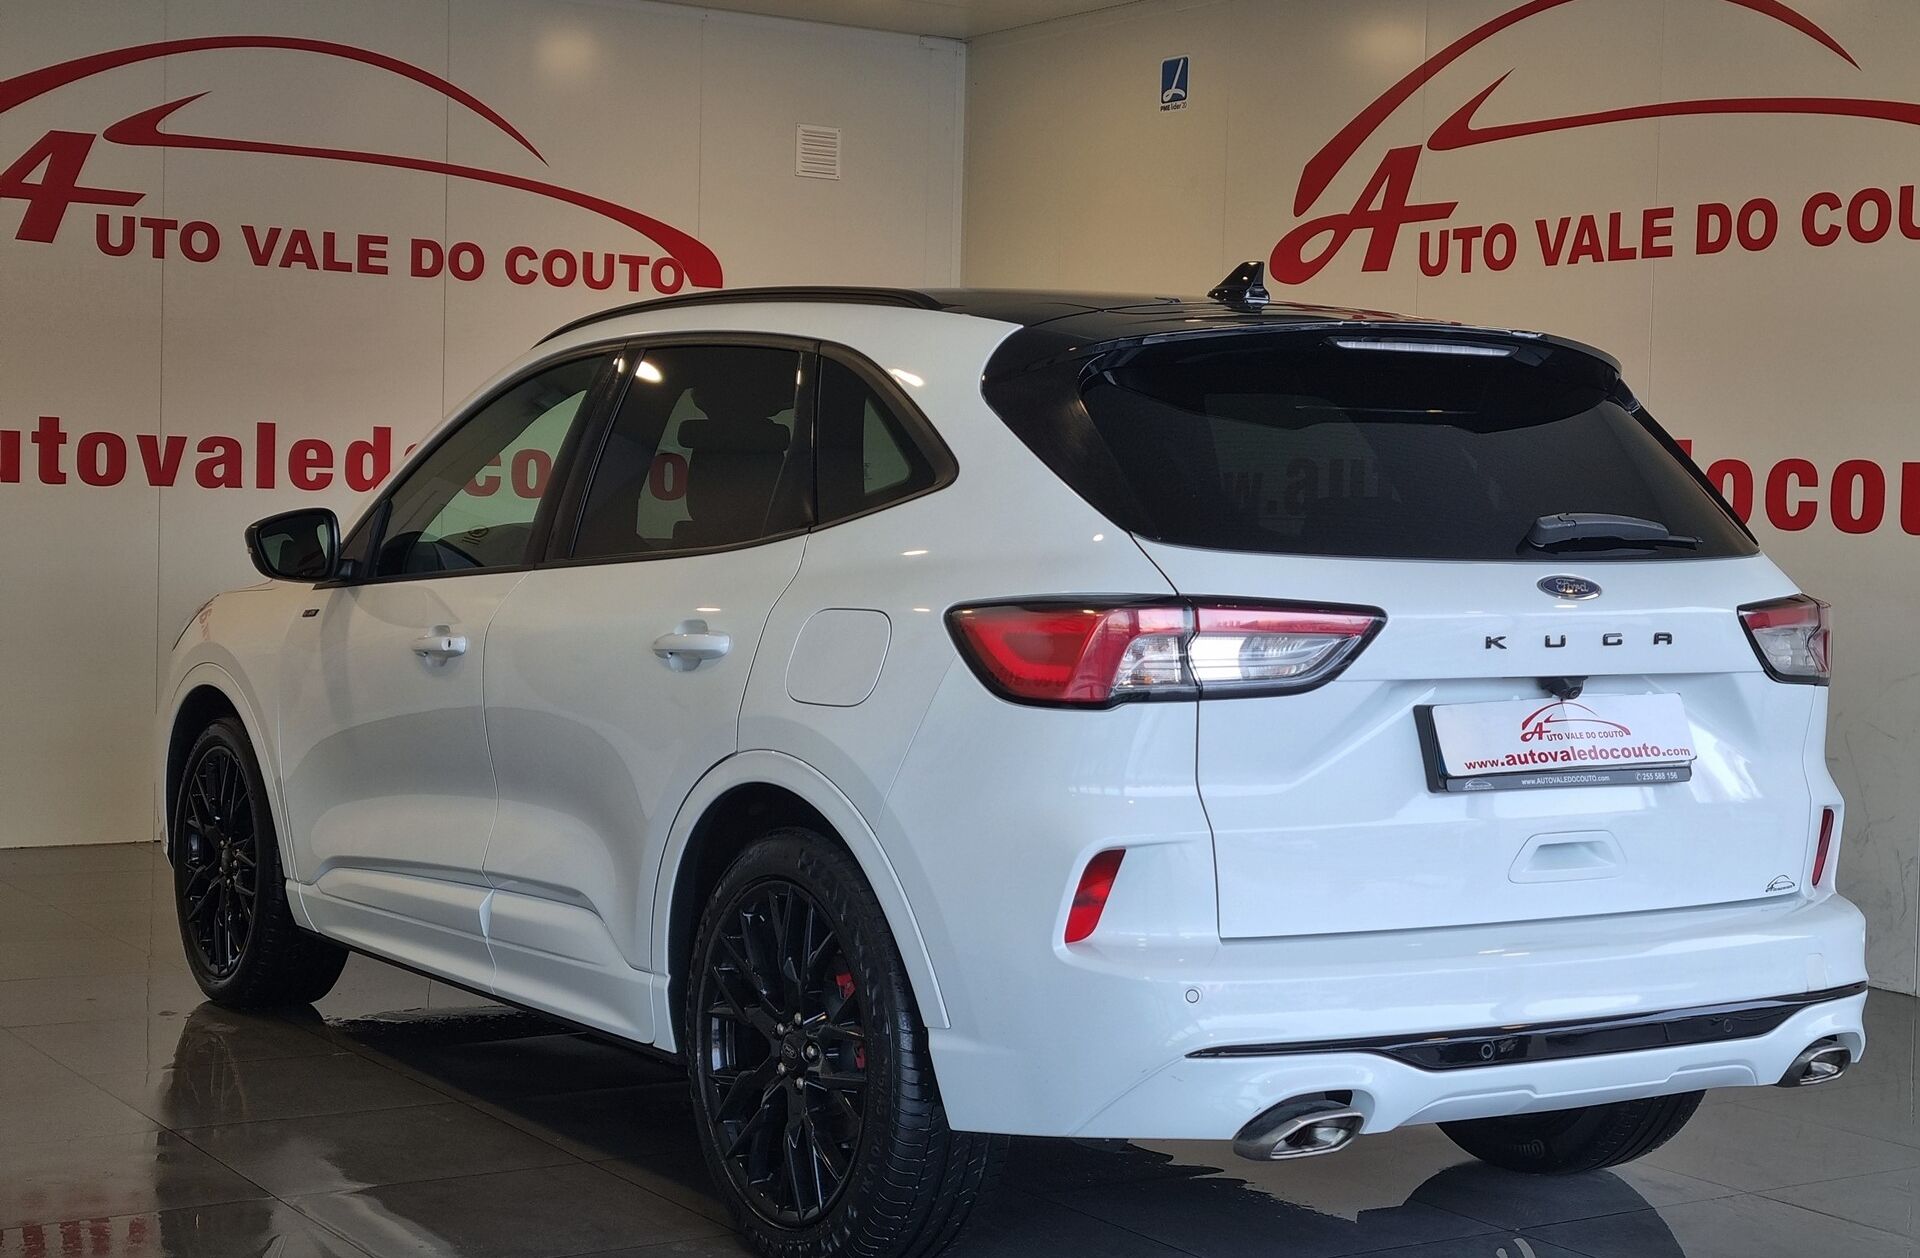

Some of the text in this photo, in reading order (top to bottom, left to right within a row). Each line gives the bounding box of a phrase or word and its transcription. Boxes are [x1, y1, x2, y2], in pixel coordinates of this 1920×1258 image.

[1536, 207, 1674, 266] VALE
[1696, 198, 1778, 255] DO
[242, 225, 389, 275] VALE
[411, 238, 485, 282] DO
[504, 246, 686, 296] COUTO
[1555, 578, 1590, 593] Ford
[1485, 631, 1673, 650] KUGA
[1564, 732, 1584, 740] VALE
[1586, 731, 1597, 739] DO
[1599, 730, 1624, 739] COUTO
[1464, 743, 1690, 770] www.autovaledocouto.com
[1521, 775, 1610, 785] www.AUTOVALEDOCOUTO.com
[1642, 772, 1654, 780] 255
